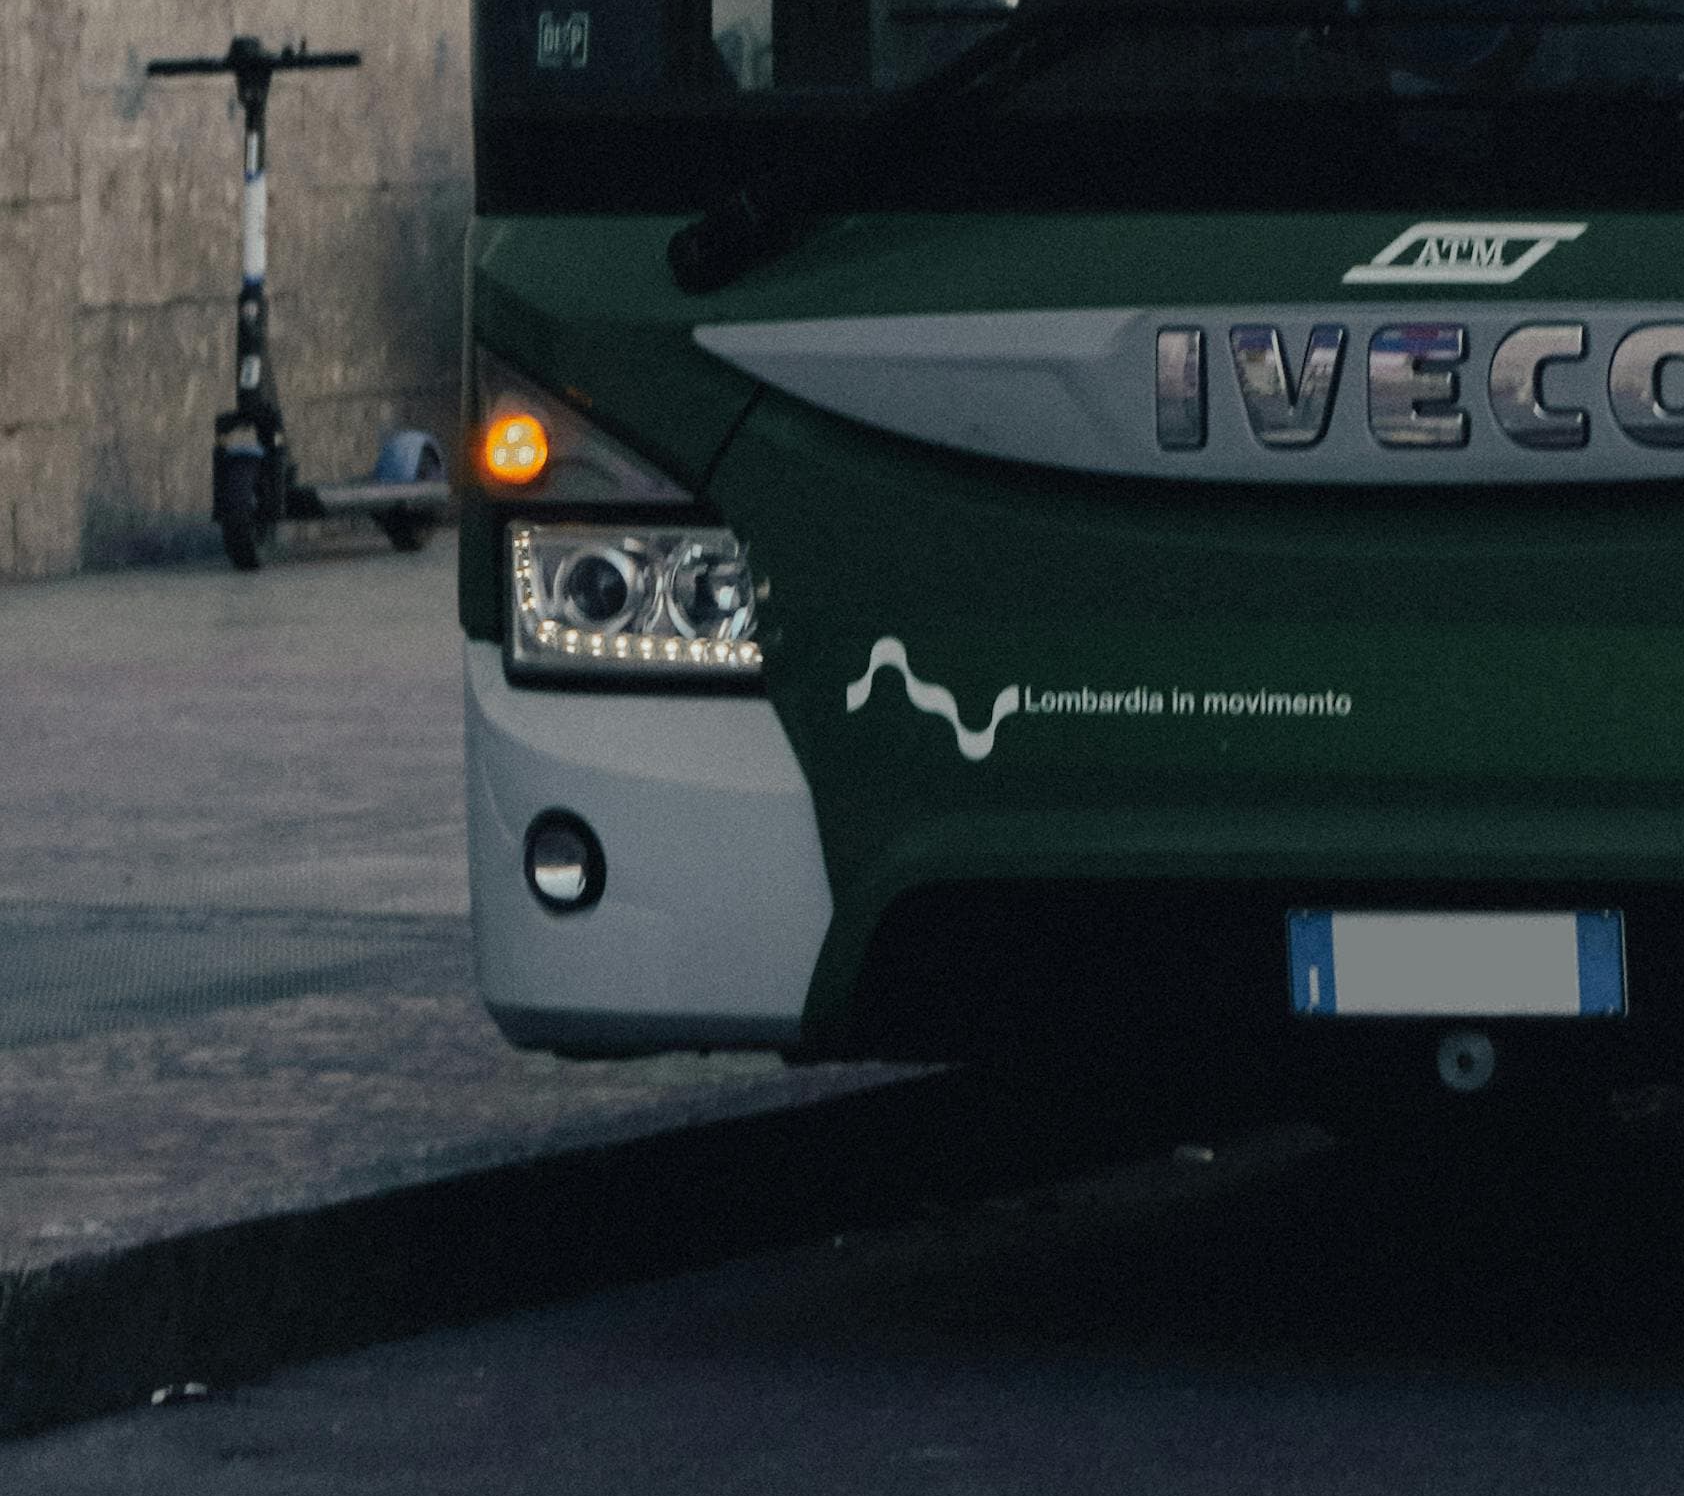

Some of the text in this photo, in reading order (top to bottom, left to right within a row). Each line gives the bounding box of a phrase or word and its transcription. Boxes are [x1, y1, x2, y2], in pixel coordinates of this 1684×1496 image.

[1412, 235, 1506, 269] ATM
[1024, 685, 1353, 717] Lombardia in movimento
